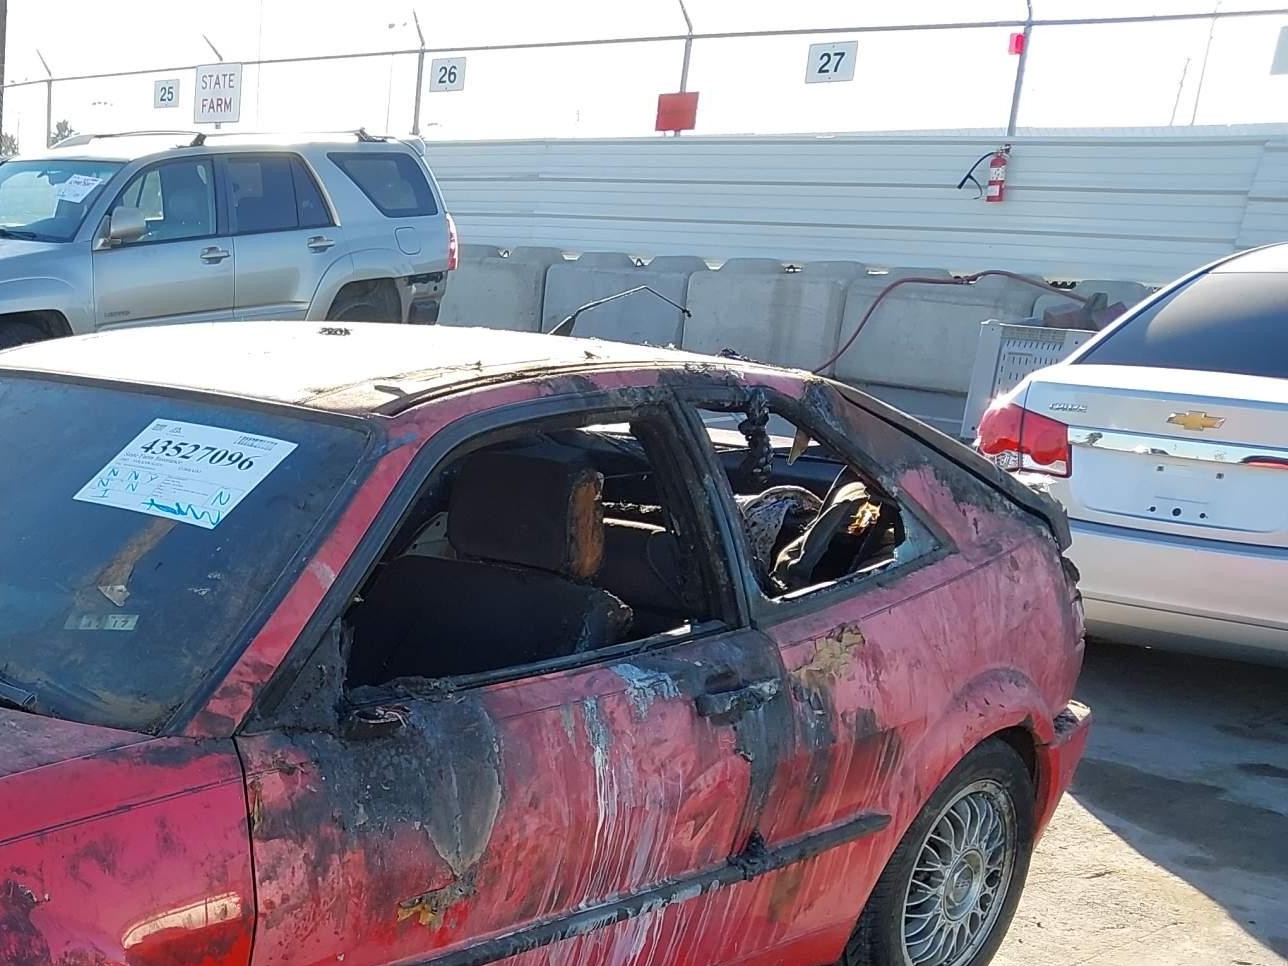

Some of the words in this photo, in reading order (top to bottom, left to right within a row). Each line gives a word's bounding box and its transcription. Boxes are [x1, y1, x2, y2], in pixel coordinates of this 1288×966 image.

[817, 52, 845, 73] 27
[201, 73, 235, 90] STATE
[438, 65, 457, 84] 26
[159, 86, 174, 101] 25
[201, 97, 232, 113] FARM
[140, 438, 261, 471] 43527096
